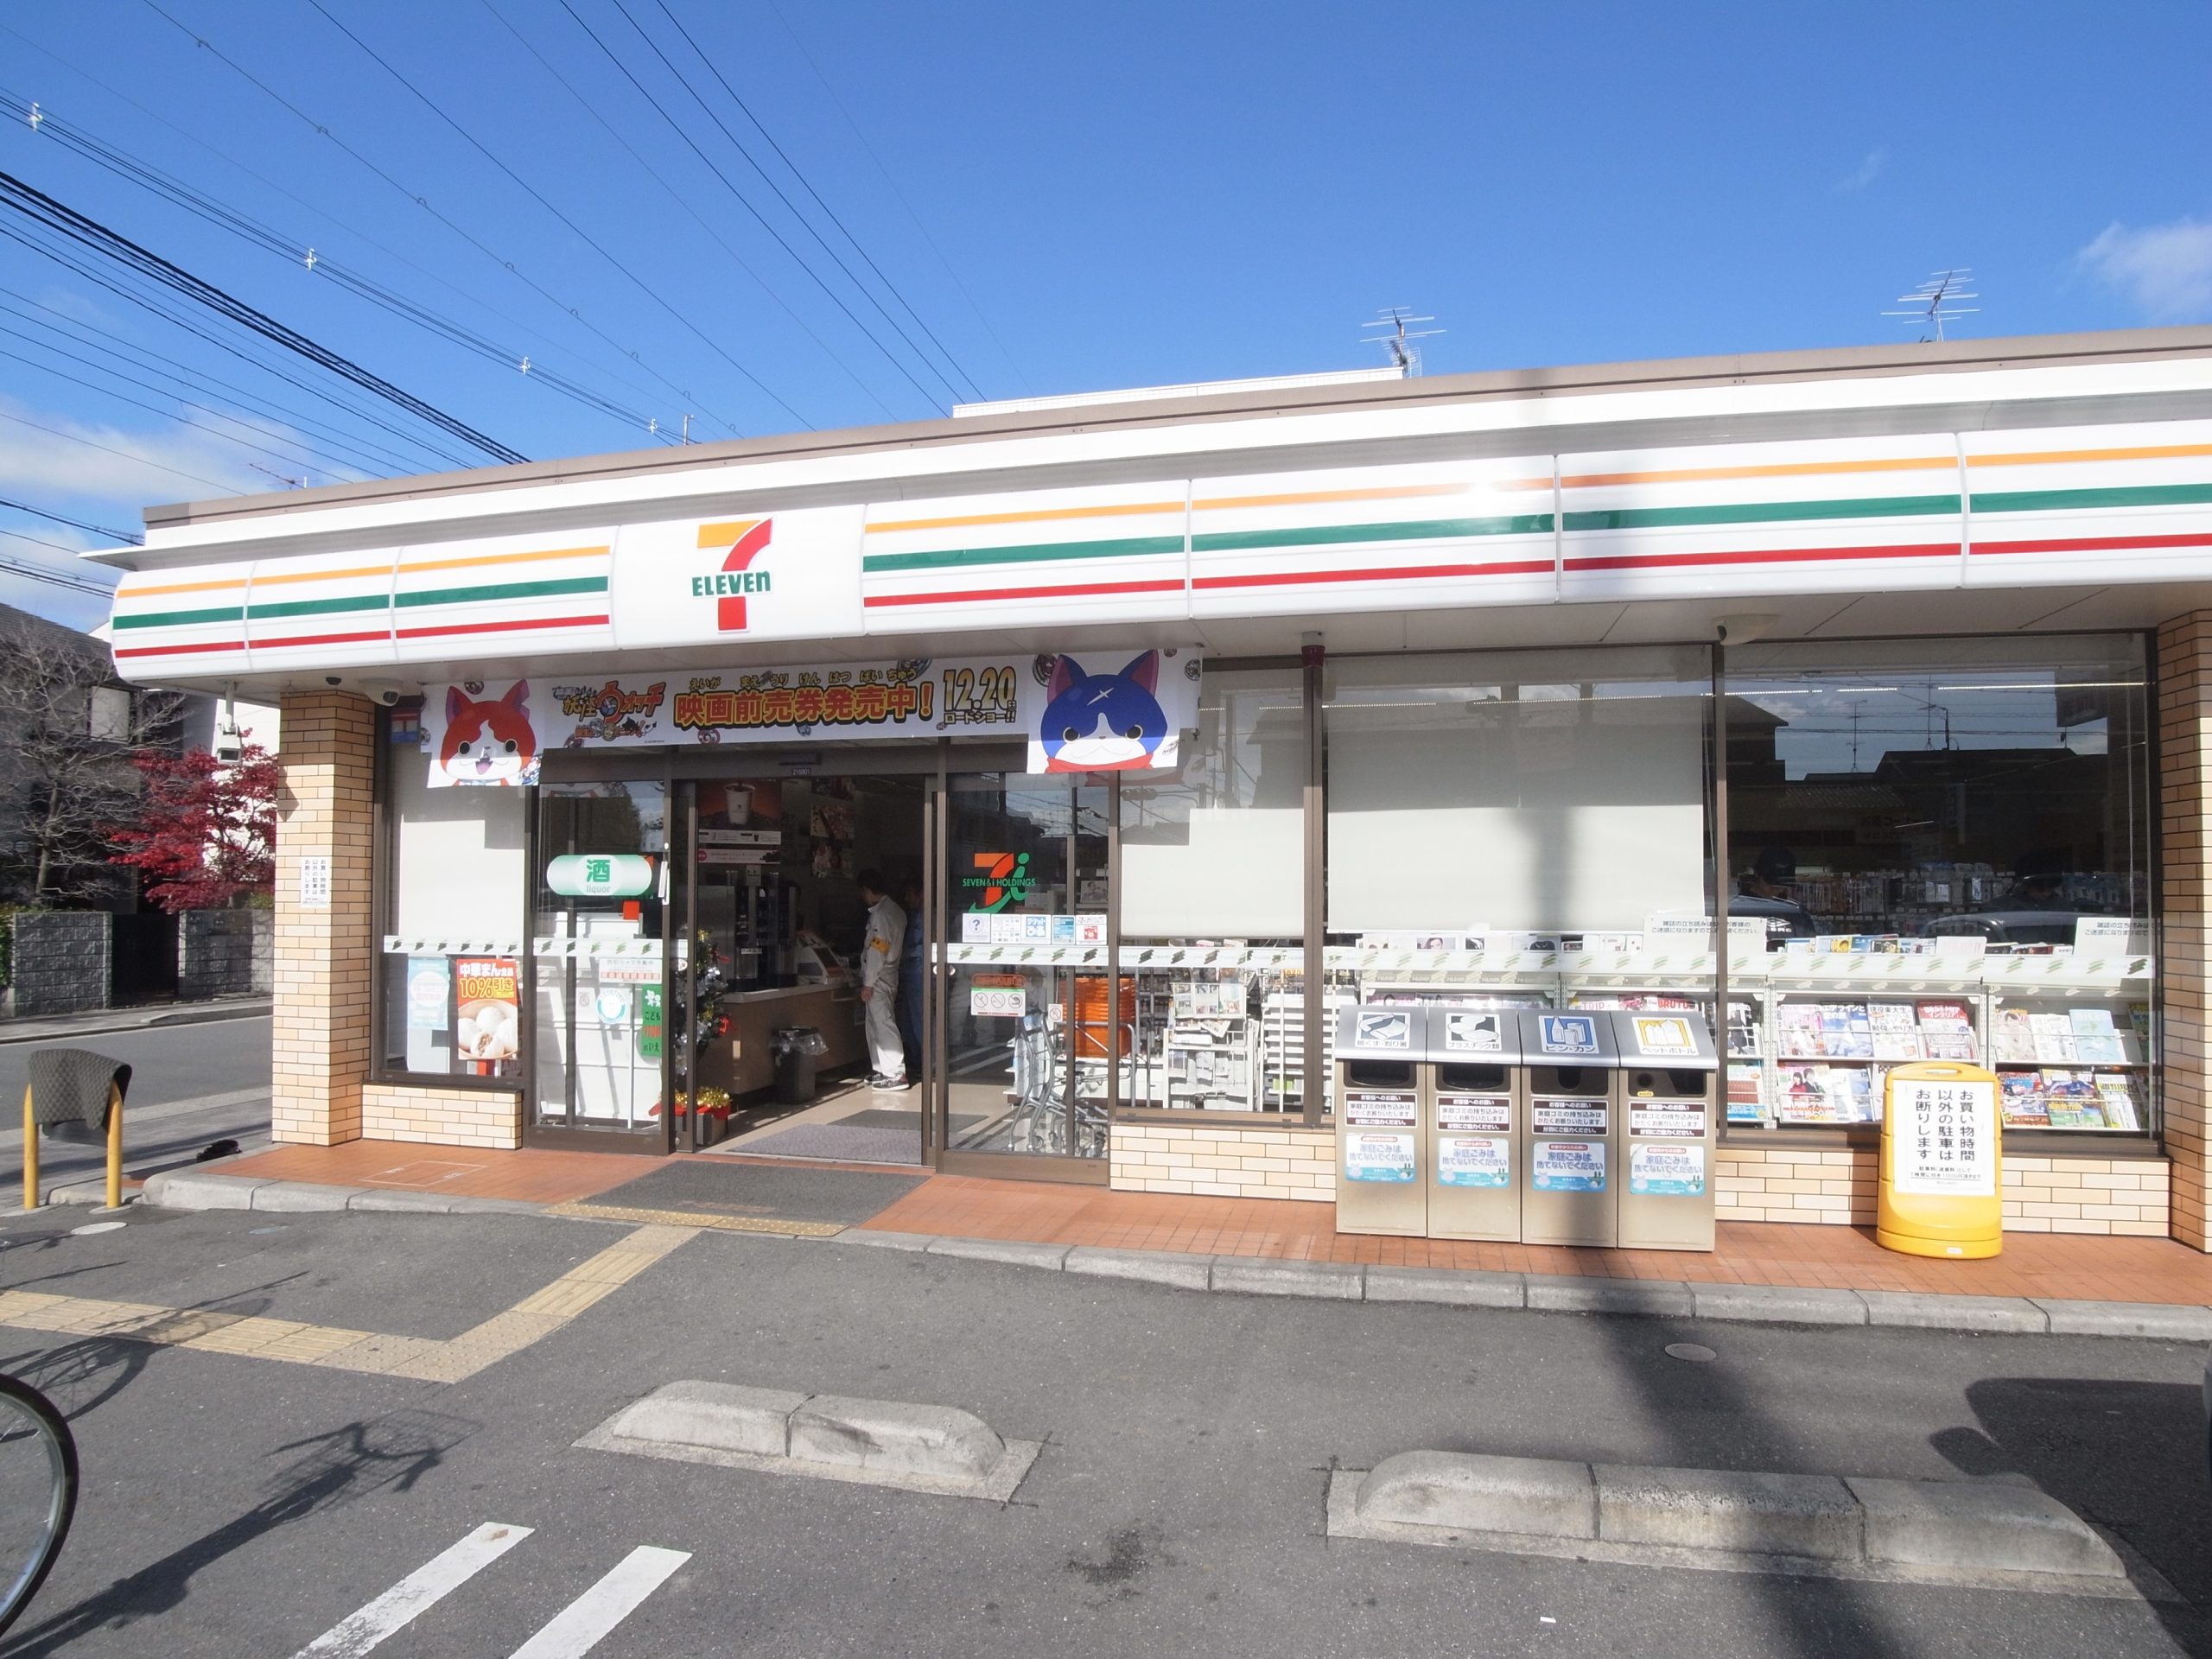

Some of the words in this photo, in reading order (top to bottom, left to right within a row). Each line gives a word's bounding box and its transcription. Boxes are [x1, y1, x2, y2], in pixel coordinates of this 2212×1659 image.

[697, 518, 772, 631] 7
[829, 671, 852, 683] はつ
[944, 666, 1016, 711] 12.20
[586, 859, 611, 882] 酒
[586, 886, 611, 894] liquor
[996, 878, 1036, 887] HOLDINGS
[1916, 1090, 1932, 1160] お断りします
[1938, 1090, 1955, 1160] 以外の駐車は
[1960, 1090, 1975, 1161] お買い物時間
